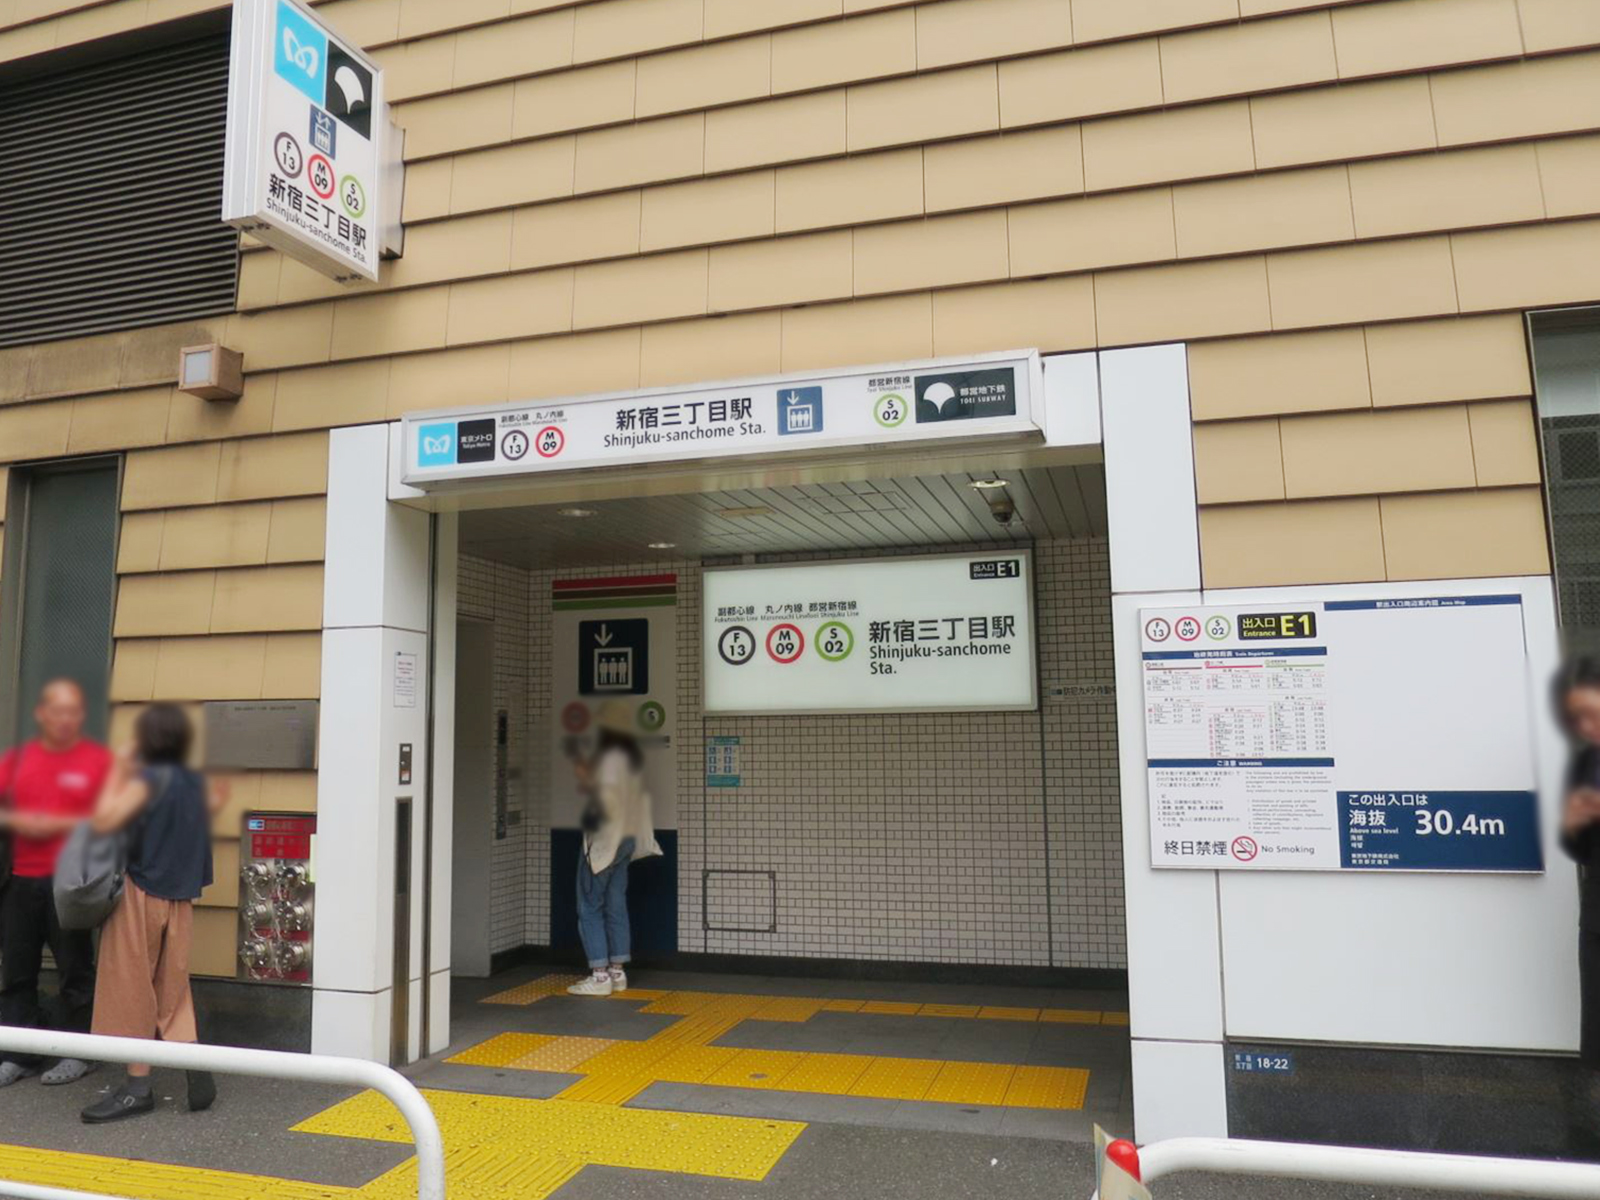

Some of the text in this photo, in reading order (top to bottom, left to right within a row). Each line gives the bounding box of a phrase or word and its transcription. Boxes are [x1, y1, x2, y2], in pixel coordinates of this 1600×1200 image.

[286, 141, 292, 152] F
[283, 152, 296, 170] 13
[316, 162, 326, 176] M
[314, 174, 328, 190] 09
[350, 183, 356, 195] S
[345, 194, 359, 211] 02
[269, 173, 367, 250] 新宿三丁目駅
[266, 197, 351, 255] Shinjuku-sanchome
[887, 400, 894, 409] S
[978, 394, 1006, 403] SUBWAY
[616, 397, 752, 431] 新宿三丁目駅
[882, 410, 899, 421] 02
[460, 433, 493, 443] 東京メトロ
[512, 435, 518, 443] F
[545, 432, 555, 440] M
[604, 422, 767, 449] Shinjuku-sanchome Sta.
[509, 445, 522, 454] 13
[542, 441, 557, 451] 09
[973, 561, 1017, 577] 出入口 E1
[717, 601, 858, 616] 副都心線 丸ノ内線 都営新宿線
[869, 615, 1016, 644] 新宿三丁目駅
[1242, 614, 1311, 636] 出入口 E1
[779, 631, 791, 641] M
[829, 628, 838, 639] S
[1152, 629, 1165, 637] 13
[1181, 627, 1195, 636] 09
[1211, 627, 1225, 636] 02
[733, 633, 740, 643] F
[729, 645, 746, 656] 13
[775, 643, 795, 655] 09
[824, 641, 844, 653] 02
[870, 641, 1011, 661] Shinjuku-sanchome
[870, 661, 897, 675] Sta.
[1348, 794, 1428, 806] この出入口は
[1349, 809, 1386, 826] 海抜
[1415, 810, 1505, 835] 30.4m
[1164, 840, 1227, 856] 終日禁煙
[1261, 845, 1315, 855] No Smoking
[1257, 1057, 1289, 1070] 18-22
